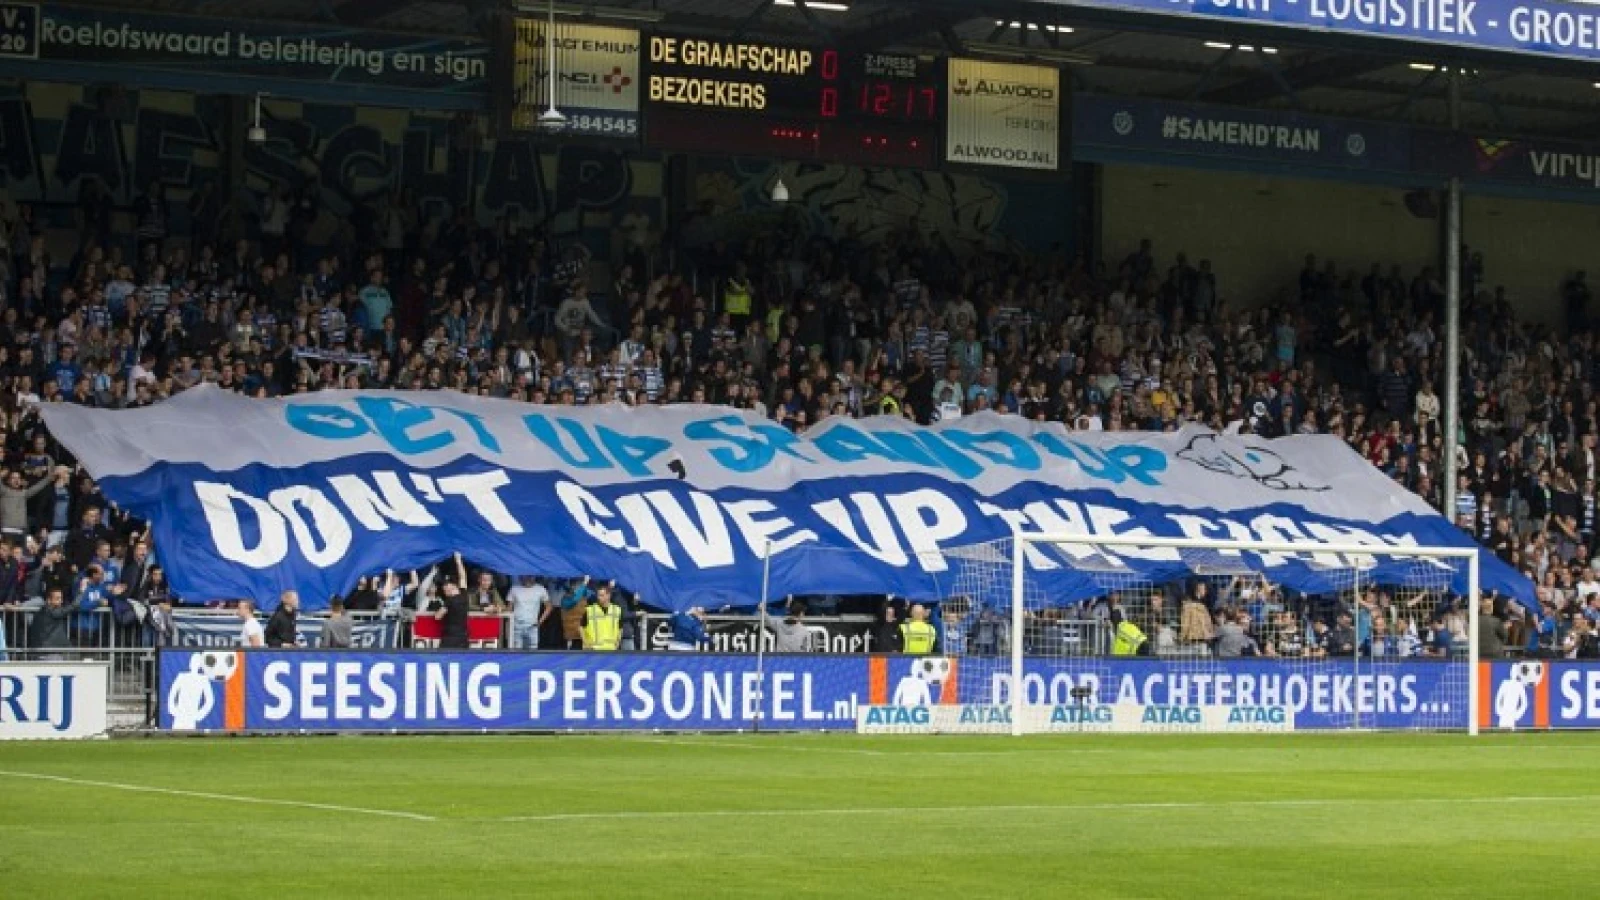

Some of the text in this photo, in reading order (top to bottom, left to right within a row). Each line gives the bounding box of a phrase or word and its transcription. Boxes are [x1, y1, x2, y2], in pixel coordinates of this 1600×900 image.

[1309, 0, 1477, 35] LOGISTIEK
[1508, 6, 1600, 49] GROE
[42, 16, 486, 81] Roelofswaard belettering en sign
[651, 37, 838, 80] DE GRAAFSCHAP 0
[535, 70, 598, 84] VNCI
[649, 76, 838, 117] BEZOEKERS 0
[975, 80, 1054, 99] ALWOOD
[1162, 115, 1320, 152] #SAMEND'RAN
[285, 395, 501, 455] GET
[1033, 430, 1168, 487] UP
[193, 469, 524, 570] DON'T
[554, 479, 818, 572] GIVE
[810, 487, 968, 573] UP
[975, 497, 1182, 571] THE
[0, 674, 76, 731] RIJ
[263, 660, 858, 722] SEESING PERSONEEL.nl
[992, 672, 1101, 707] DOOR
[866, 705, 931, 725] ATAG
[1050, 704, 1113, 724] ATAG
[1142, 704, 1202, 723] ATAG
[1228, 705, 1287, 724] ATAG
